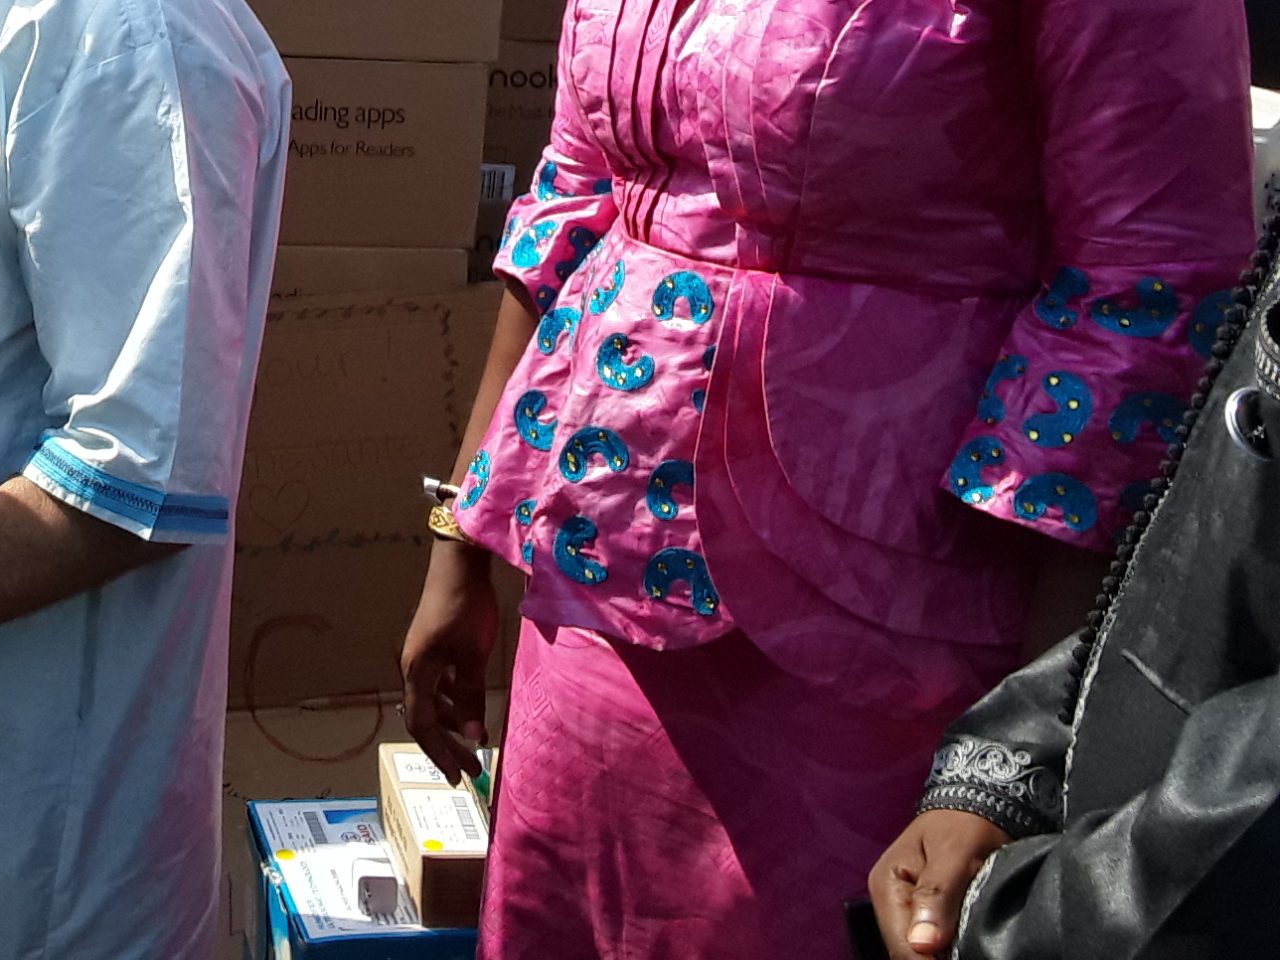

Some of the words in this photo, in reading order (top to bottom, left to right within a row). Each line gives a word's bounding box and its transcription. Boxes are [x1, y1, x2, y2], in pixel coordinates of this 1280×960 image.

[355, 105, 406, 130] apps
[288, 139, 328, 159] Apps
[330, 140, 349, 156] for
[355, 140, 417, 158] Readers
